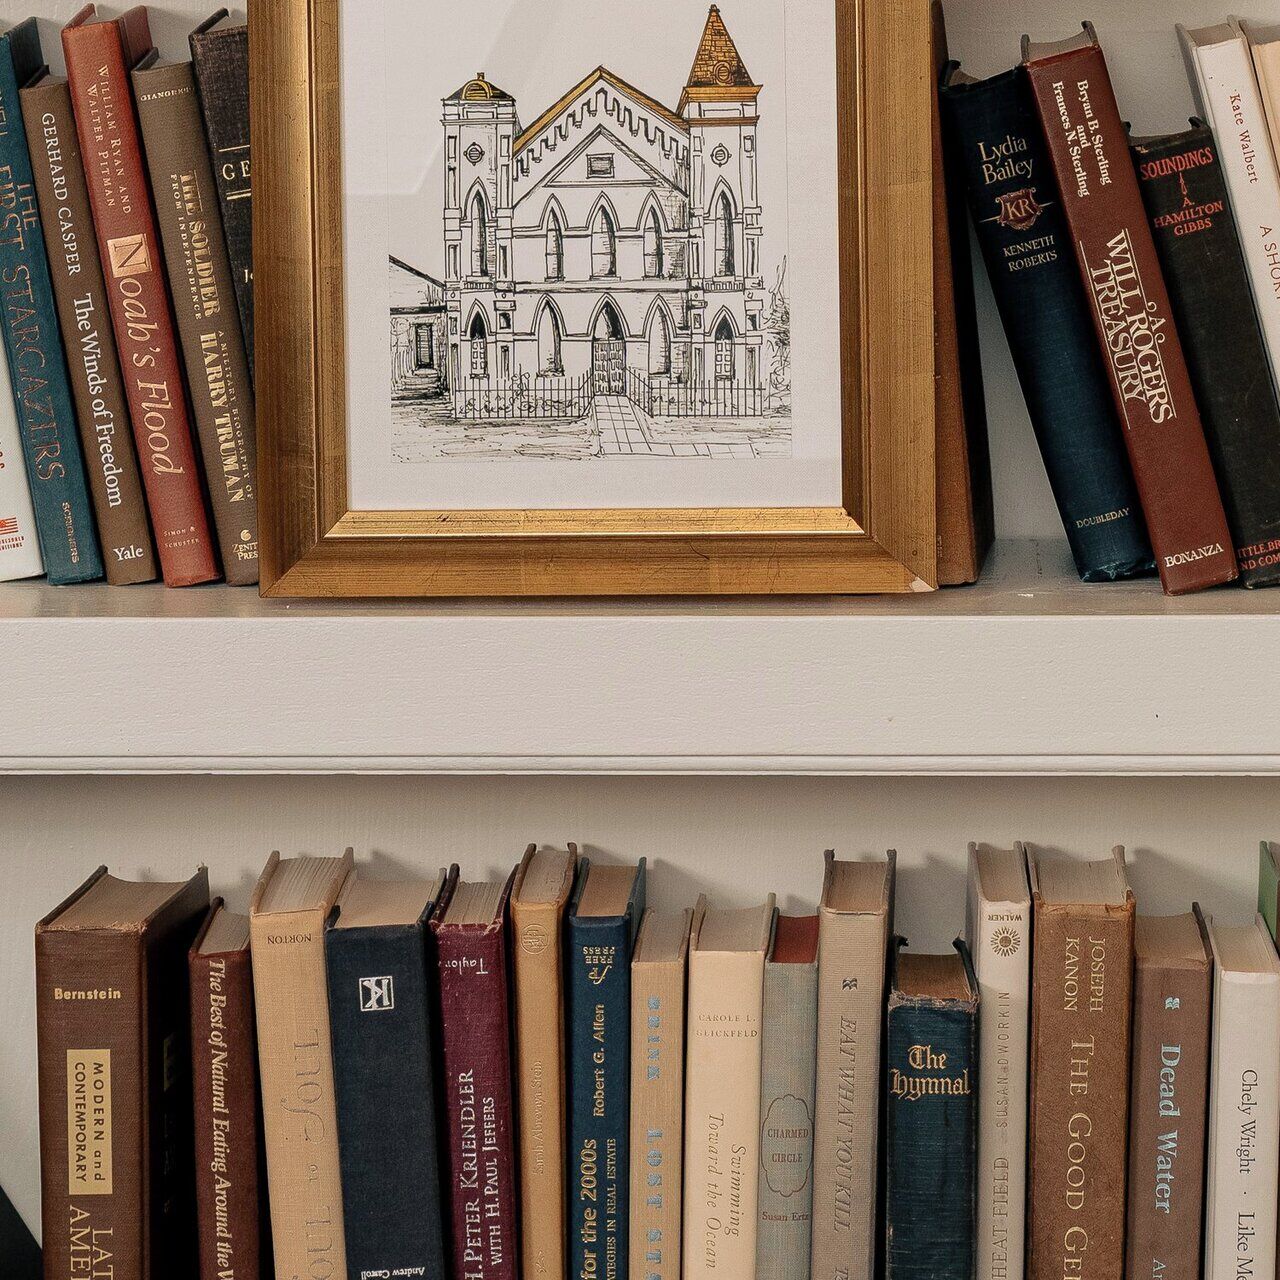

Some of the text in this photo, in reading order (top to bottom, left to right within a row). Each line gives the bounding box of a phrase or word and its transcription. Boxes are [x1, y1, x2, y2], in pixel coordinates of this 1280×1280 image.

[977, 135, 1027, 164] Lydia
[1141, 146, 1214, 181] SOUNDINGS
[981, 157, 1034, 187] Bailey
[41, 112, 82, 276] GERHARD CASPER
[1003, 236, 1055, 257] KENNETH
[1008, 250, 1058, 272] ROBERTS
[112, 543, 144, 562] Yale
[267, 933, 312, 945] NORTON
[1064, 937, 1079, 1012] KANON
[1089, 937, 1106, 1013] JOSEPH
[54, 987, 121, 1000] Bernstein
[592, 1004, 605, 1117] Robert G. Allen
[908, 1044, 948, 1071] The
[74, 1063, 87, 1183] CONTEMPORARY
[1155, 1043, 1181, 1214] Dead Water
[1237, 1069, 1258, 1176] Chely Wright
